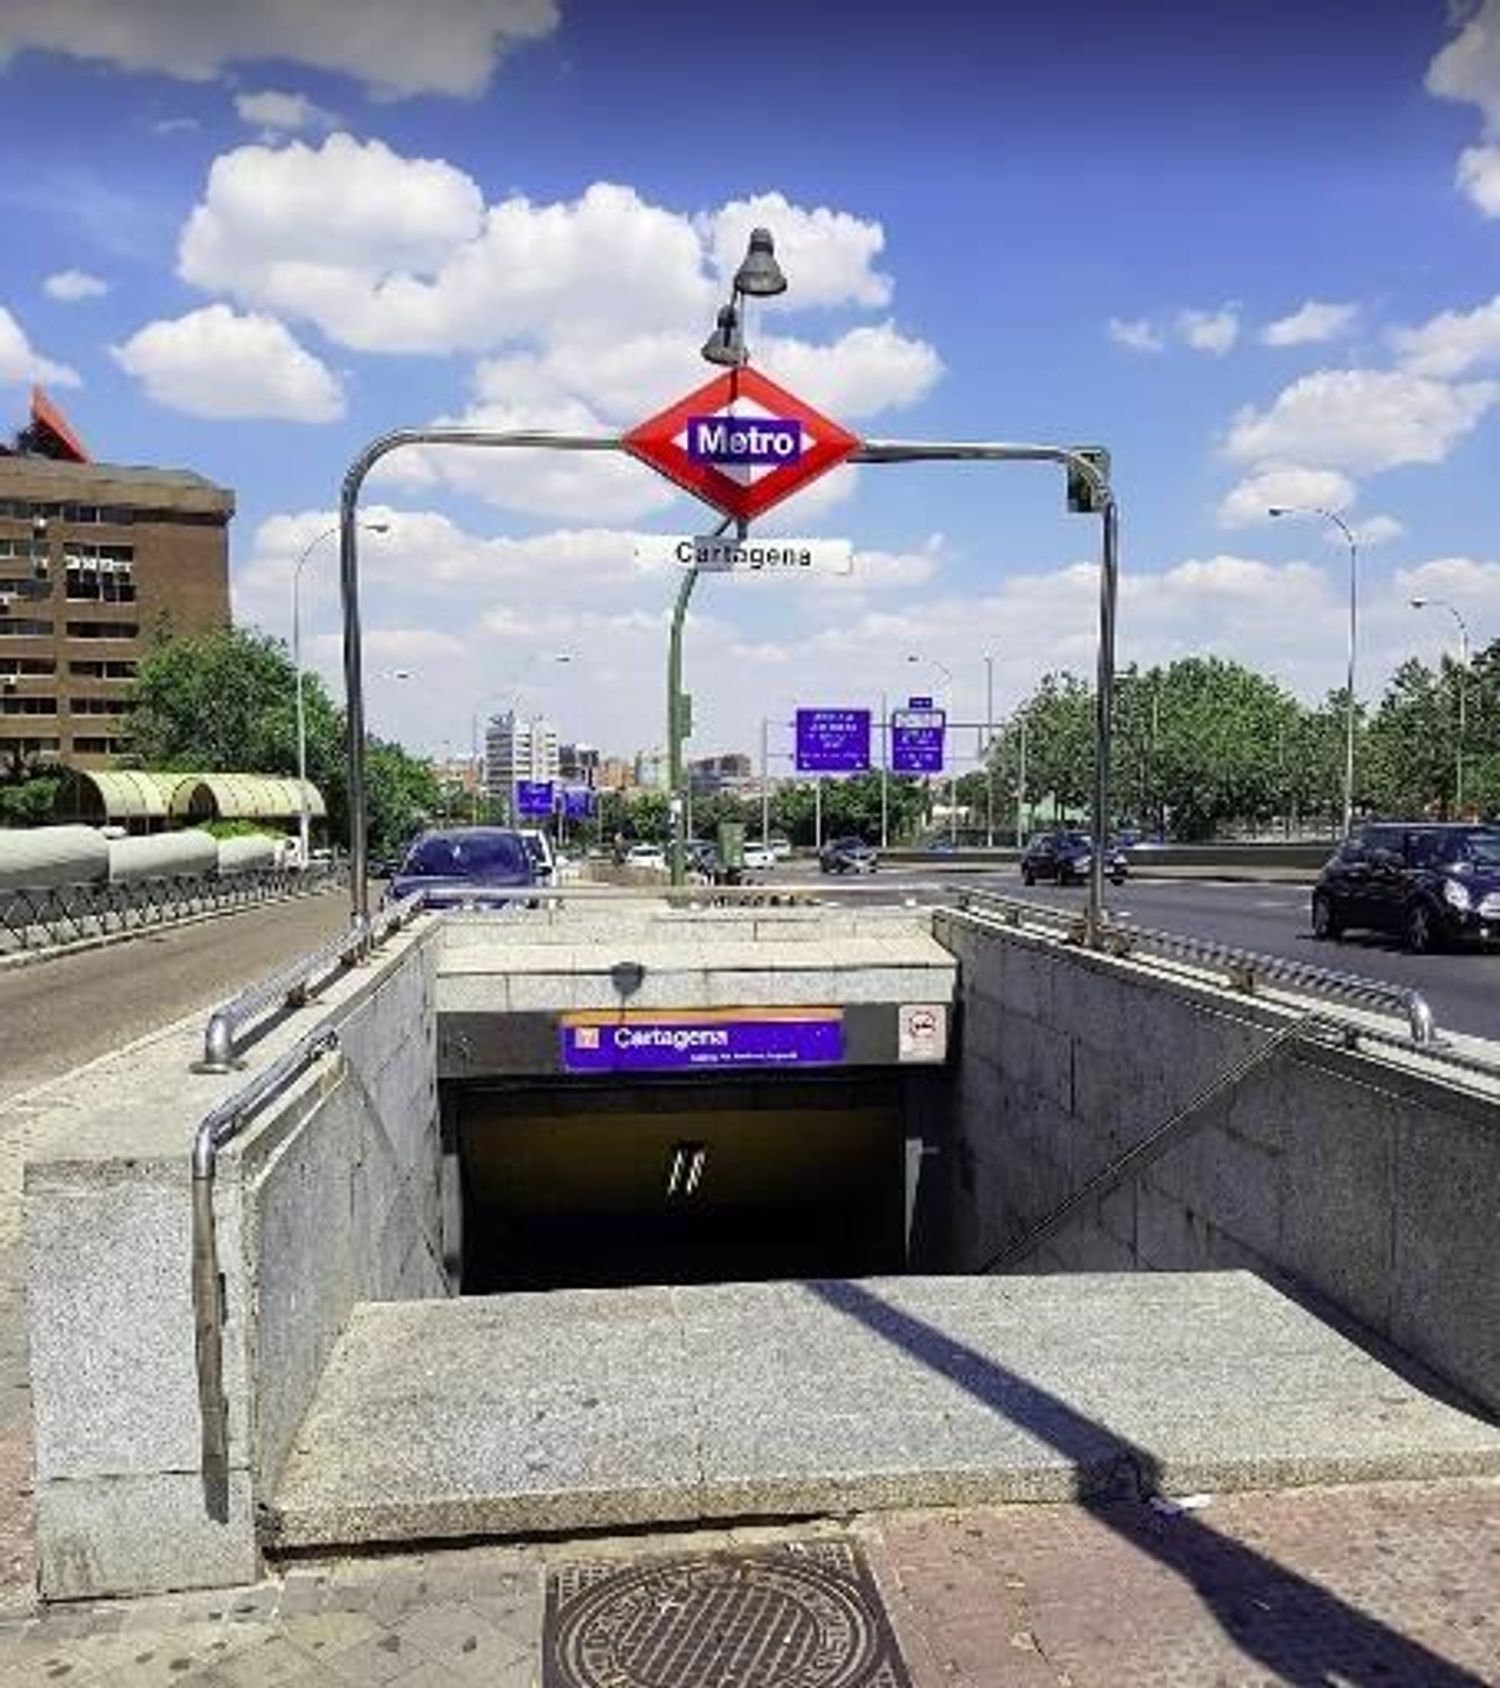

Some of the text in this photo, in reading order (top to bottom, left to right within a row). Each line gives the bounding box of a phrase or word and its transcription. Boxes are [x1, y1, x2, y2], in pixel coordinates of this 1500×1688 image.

[696, 423, 795, 455] Metro
[675, 541, 811, 569] Cartagena
[613, 1027, 729, 1051] Cartagena
